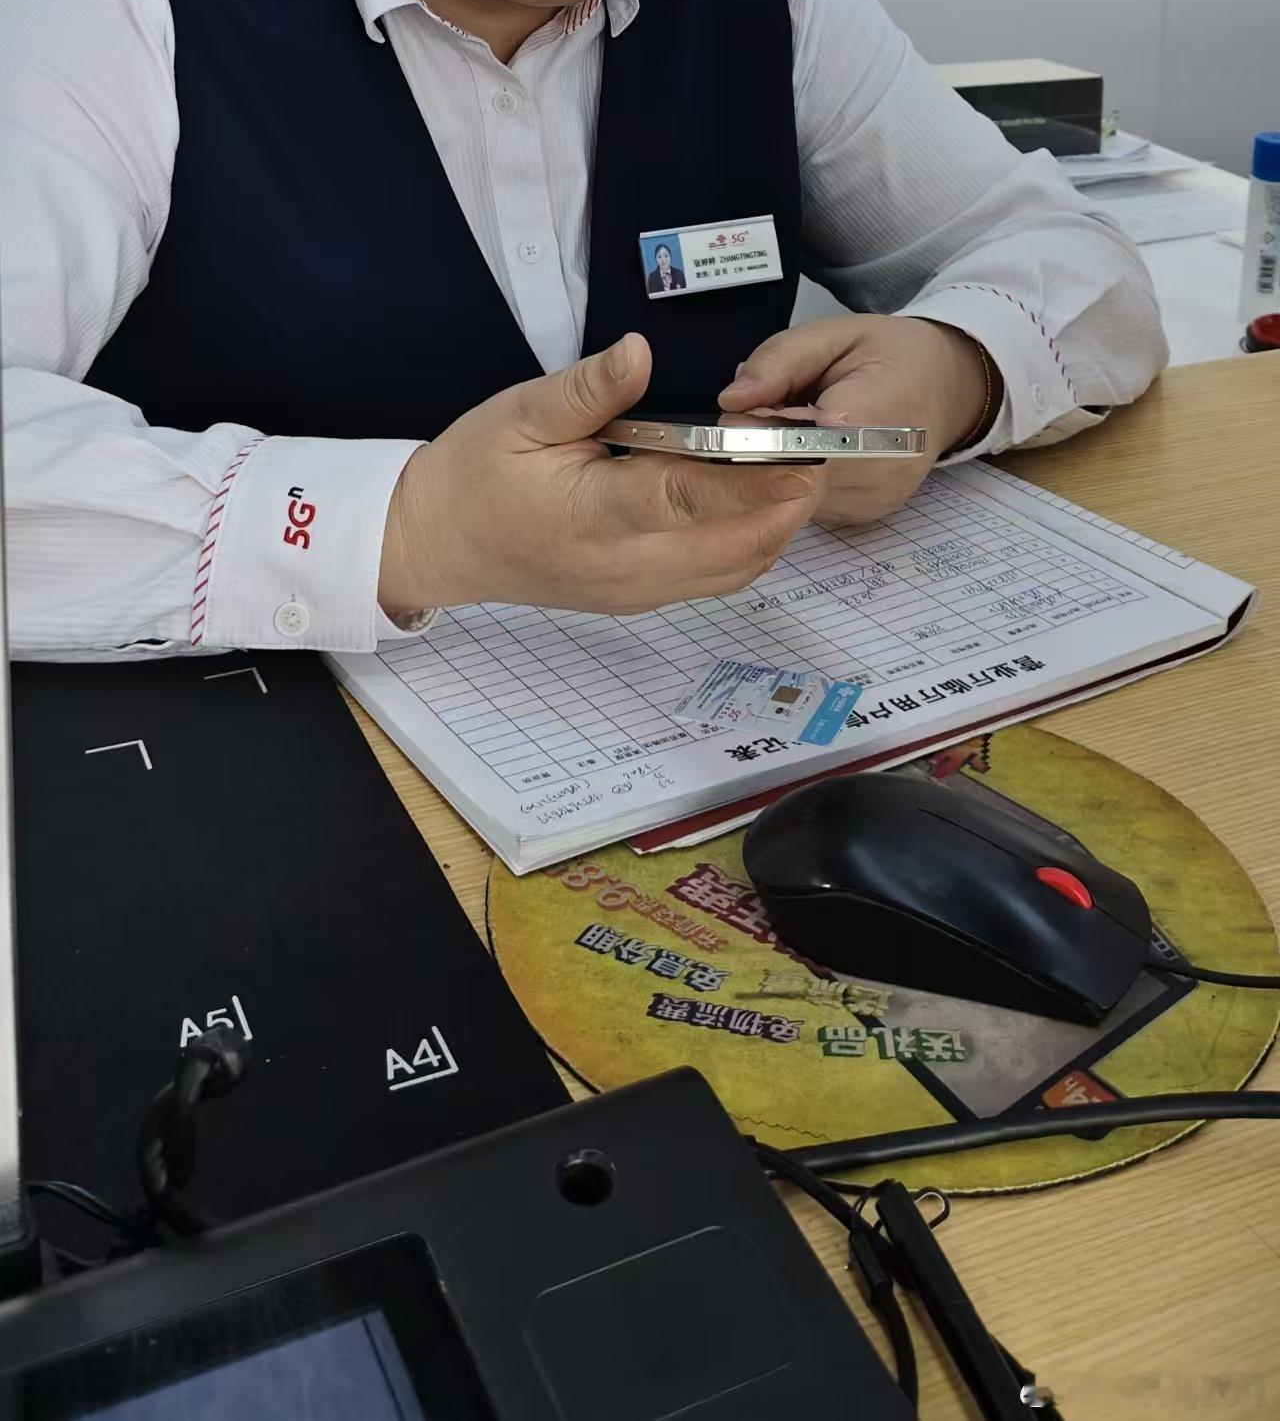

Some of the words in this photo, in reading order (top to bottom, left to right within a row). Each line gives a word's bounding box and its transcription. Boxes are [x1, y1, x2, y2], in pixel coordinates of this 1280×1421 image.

[720, 250, 767, 263] ZHANGTINGTING
[725, 654, 1046, 762] 营业厅临厅用户信记表
[574, 922, 732, 992] 免息分期
[646, 993, 805, 1043] 免物流费
[387, 1038, 443, 1081] A4
[818, 1025, 968, 1062] 送礼品
[1062, 1077, 1102, 1105] 4h
